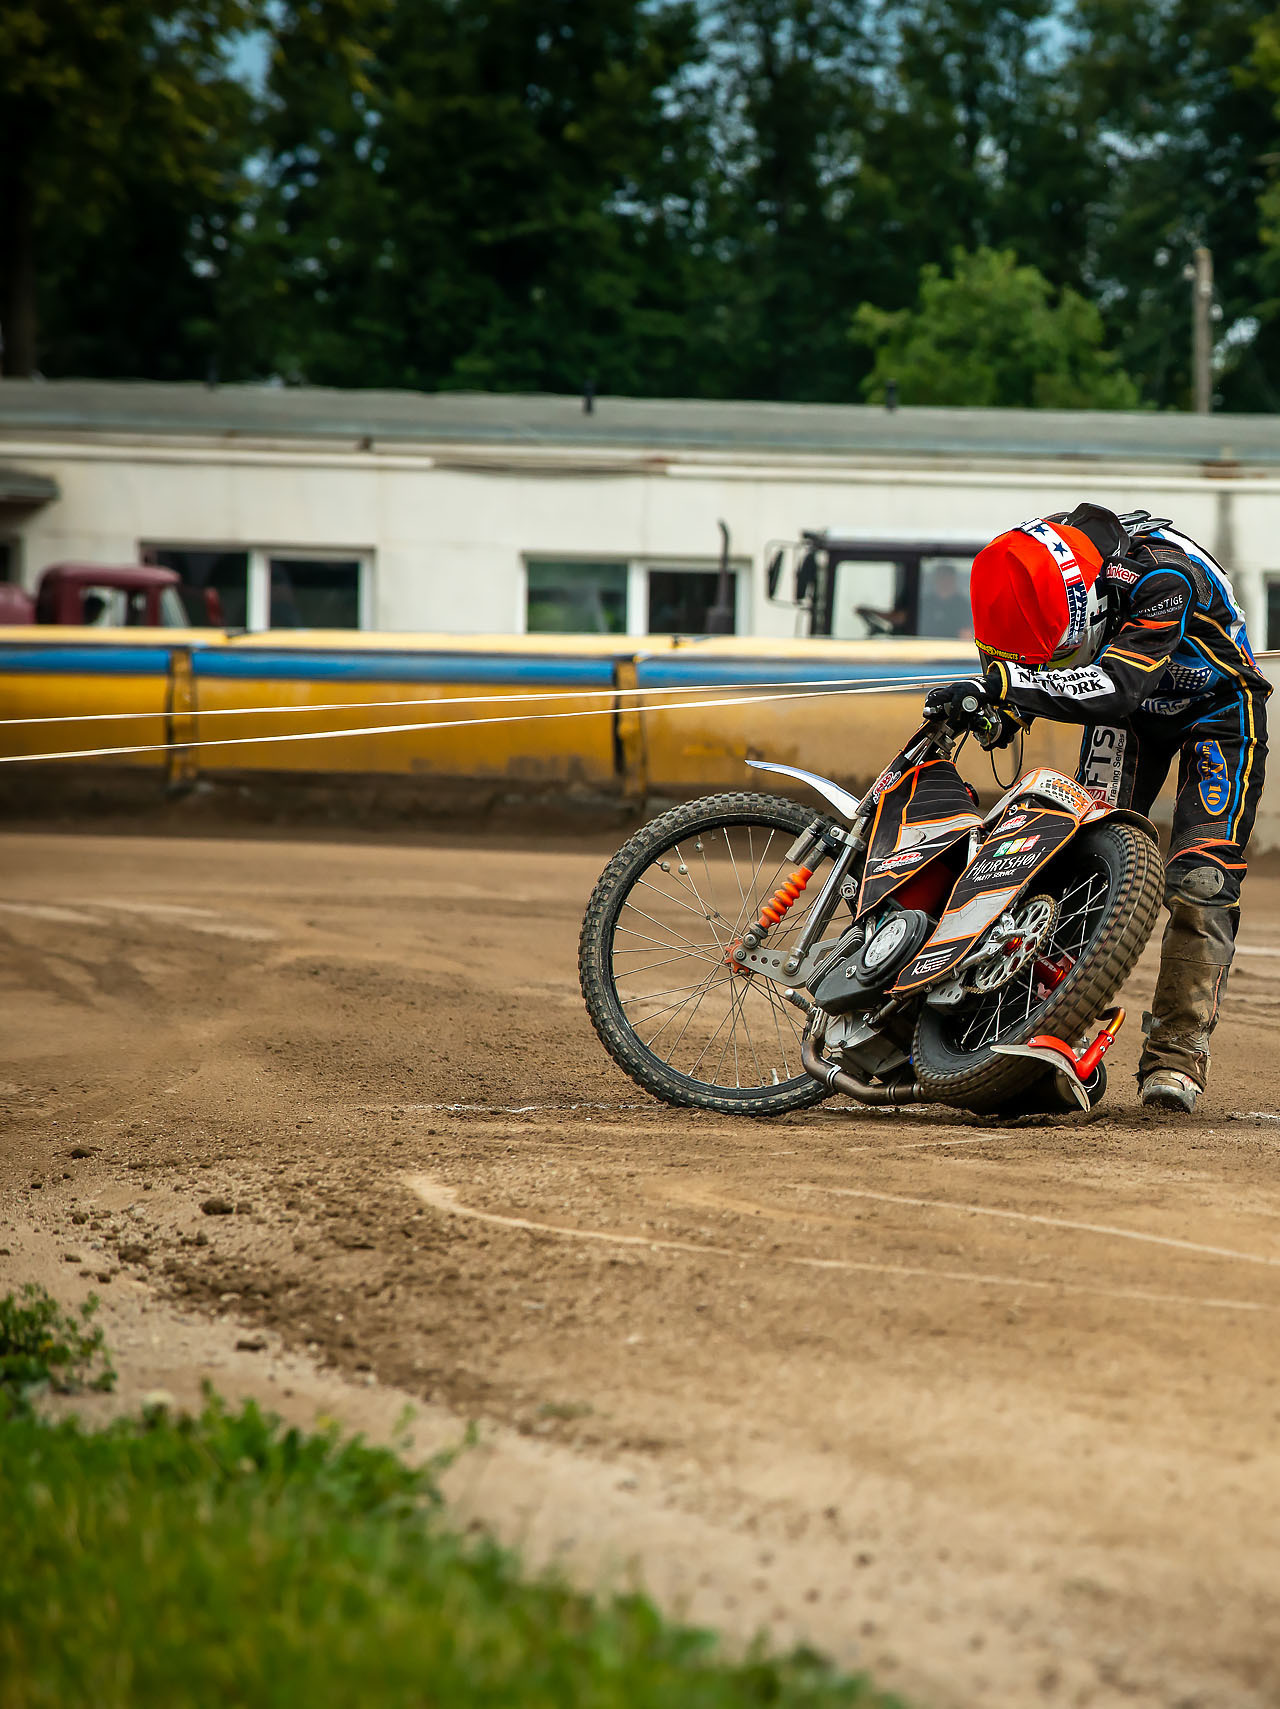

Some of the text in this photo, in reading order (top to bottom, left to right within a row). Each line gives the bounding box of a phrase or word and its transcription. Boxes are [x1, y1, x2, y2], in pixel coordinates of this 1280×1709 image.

[1086, 729, 1115, 788] FTS
[1107, 733, 1125, 802] Training Services
